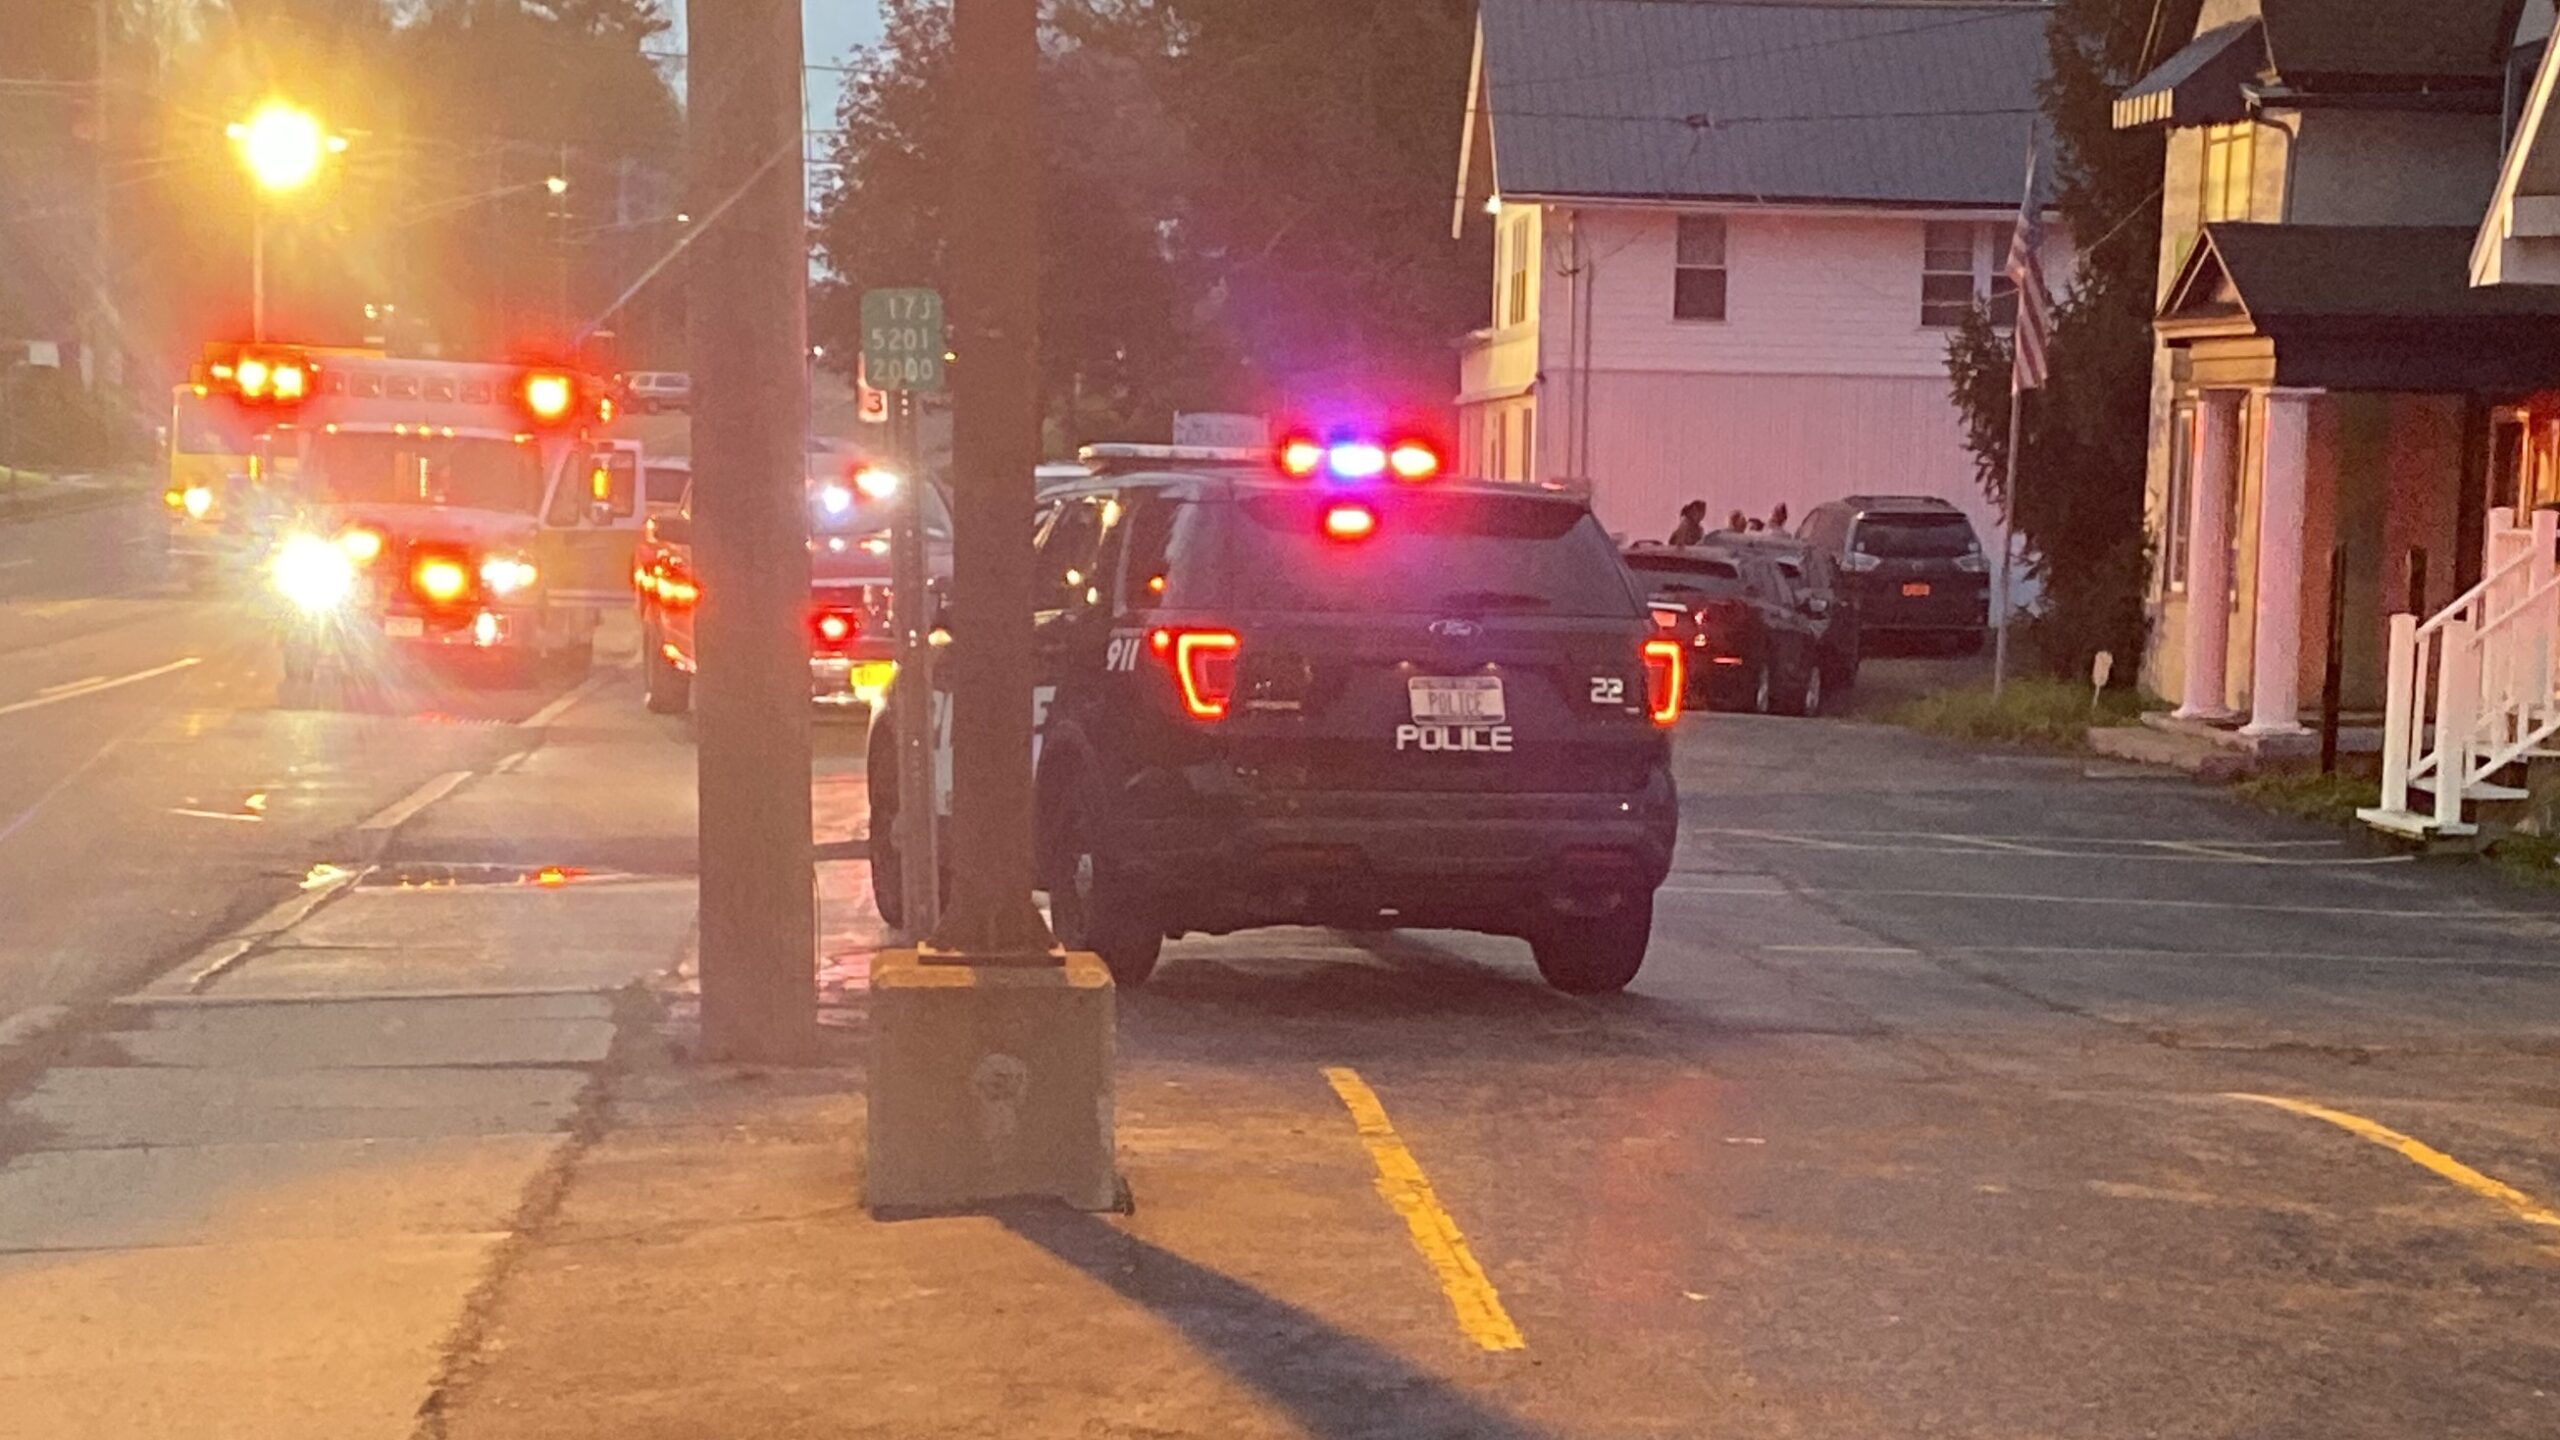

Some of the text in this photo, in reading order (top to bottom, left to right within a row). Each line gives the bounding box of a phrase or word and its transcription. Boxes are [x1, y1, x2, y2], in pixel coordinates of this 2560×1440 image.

[871, 327, 929, 350] 5201
[872, 357, 934, 381] 2000
[1106, 638, 1140, 671] 911
[1590, 676, 1624, 704] 22
[1428, 691, 1484, 717] POLICE
[1396, 724, 1514, 753] POLICE
